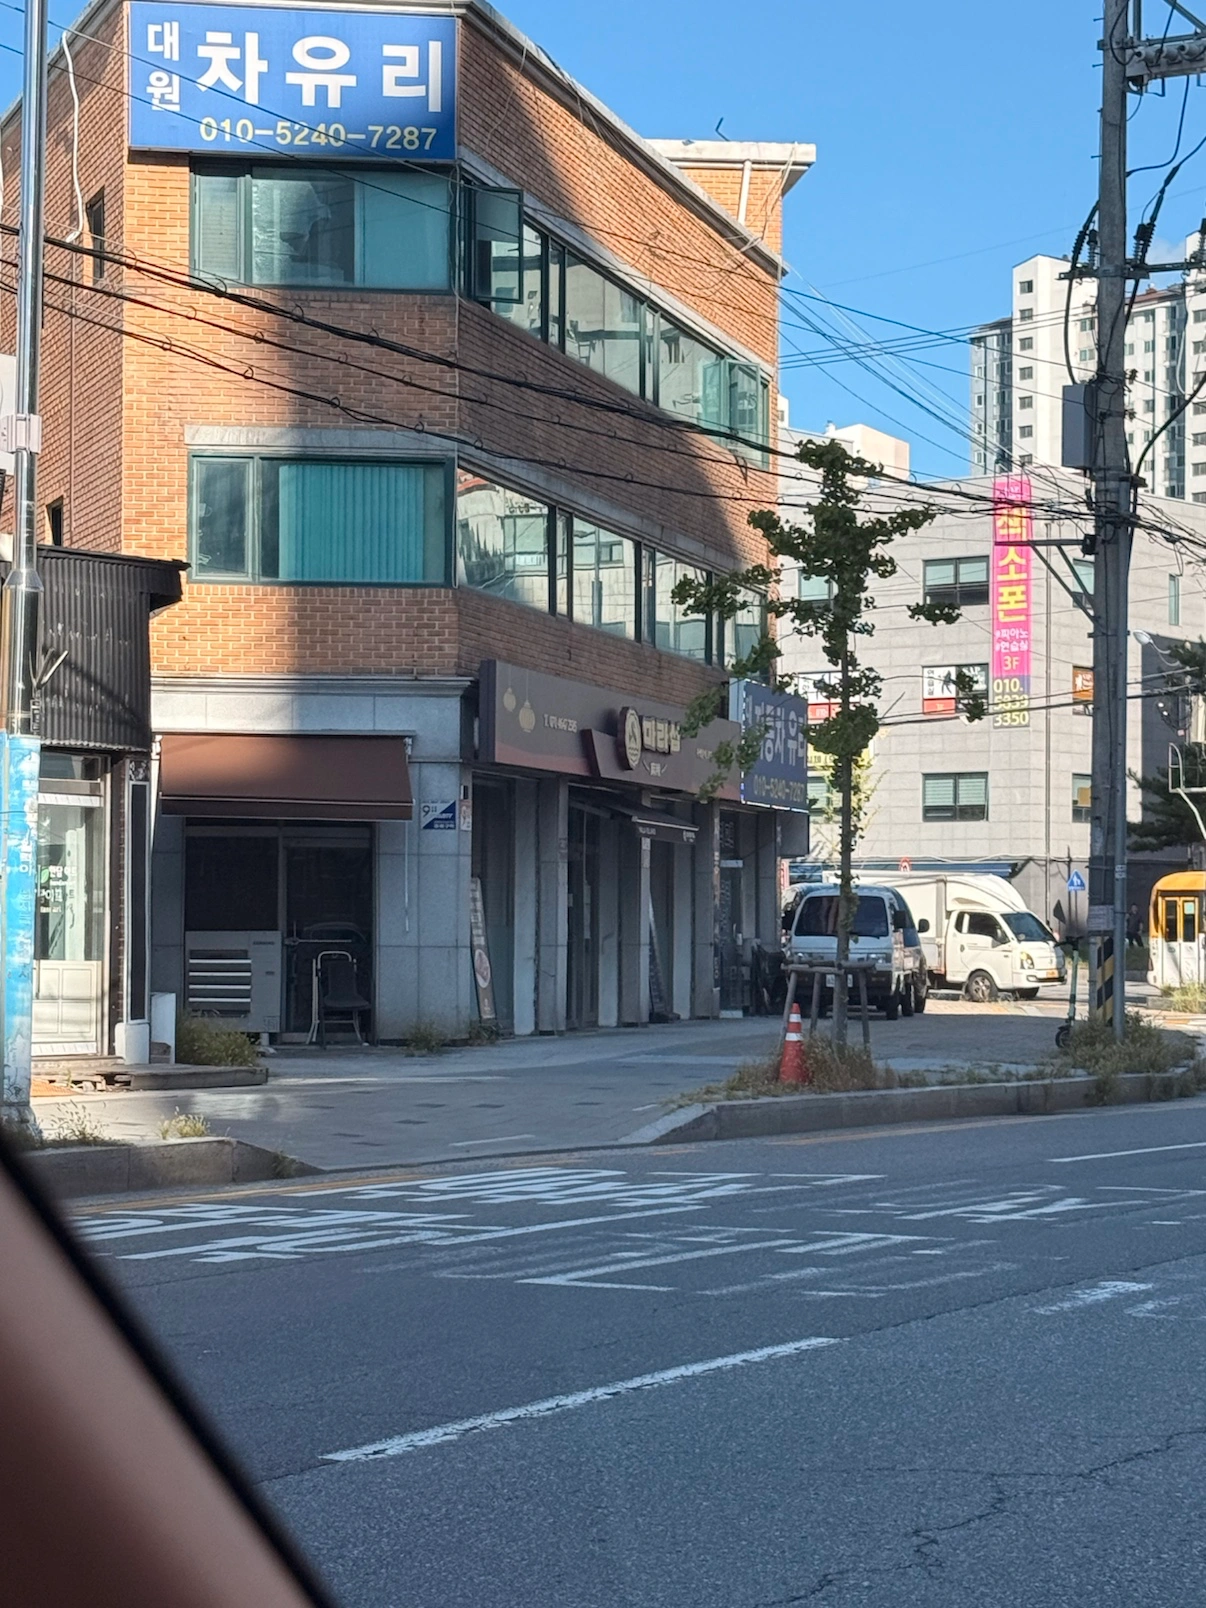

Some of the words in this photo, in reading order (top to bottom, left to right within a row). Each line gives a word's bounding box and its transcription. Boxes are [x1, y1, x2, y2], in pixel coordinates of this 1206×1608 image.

[146, 21, 181, 112] 대원
[195, 31, 442, 113] 차유리
[200, 116, 437, 150] 010-5240-7287
[1003, 656, 1019, 671] 3F
[994, 711, 1029, 727] 3350
